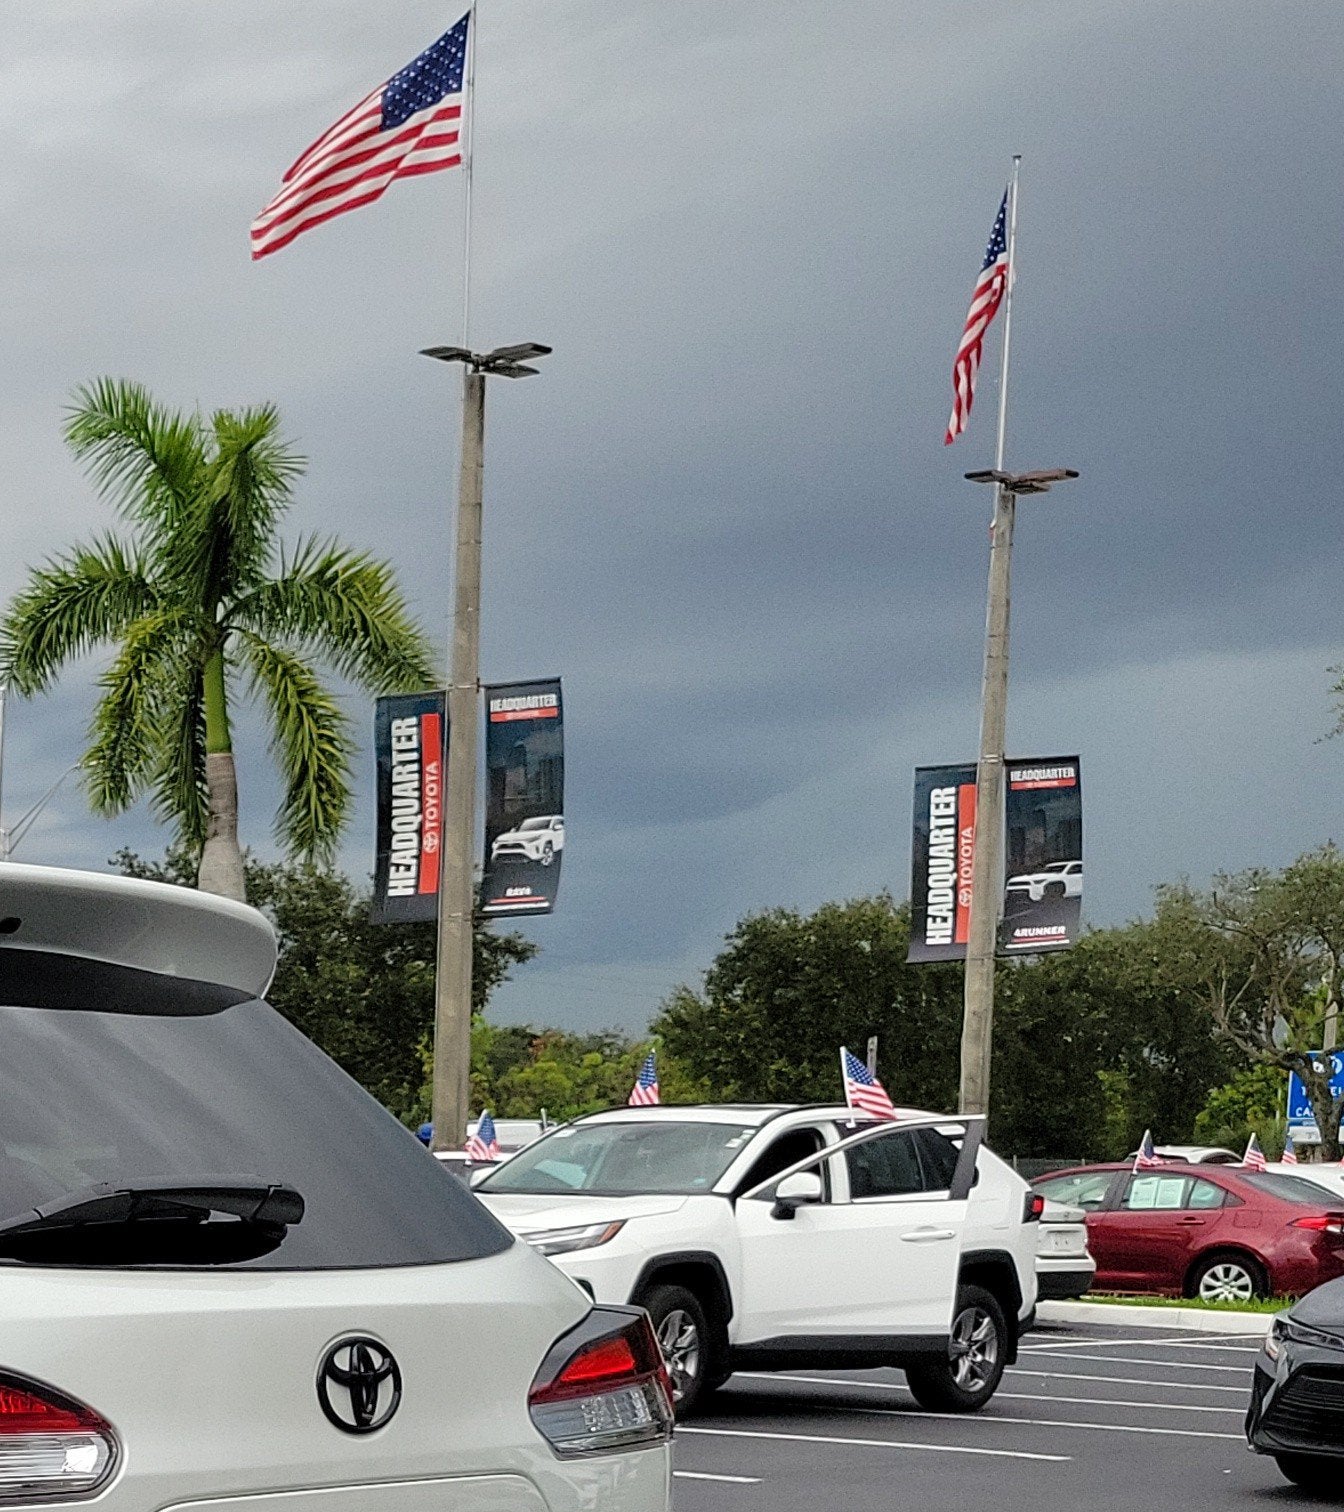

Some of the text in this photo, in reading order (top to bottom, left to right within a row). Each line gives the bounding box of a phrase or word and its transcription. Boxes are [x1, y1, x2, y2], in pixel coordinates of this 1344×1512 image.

[387, 716, 422, 896] HEADQUARTER
[425, 762, 440, 829] TOYOTA
[925, 786, 957, 945] HEADQUARTER
[960, 827, 973, 886] TOYOTA
[1014, 926, 1066, 937] 4RUNNER
